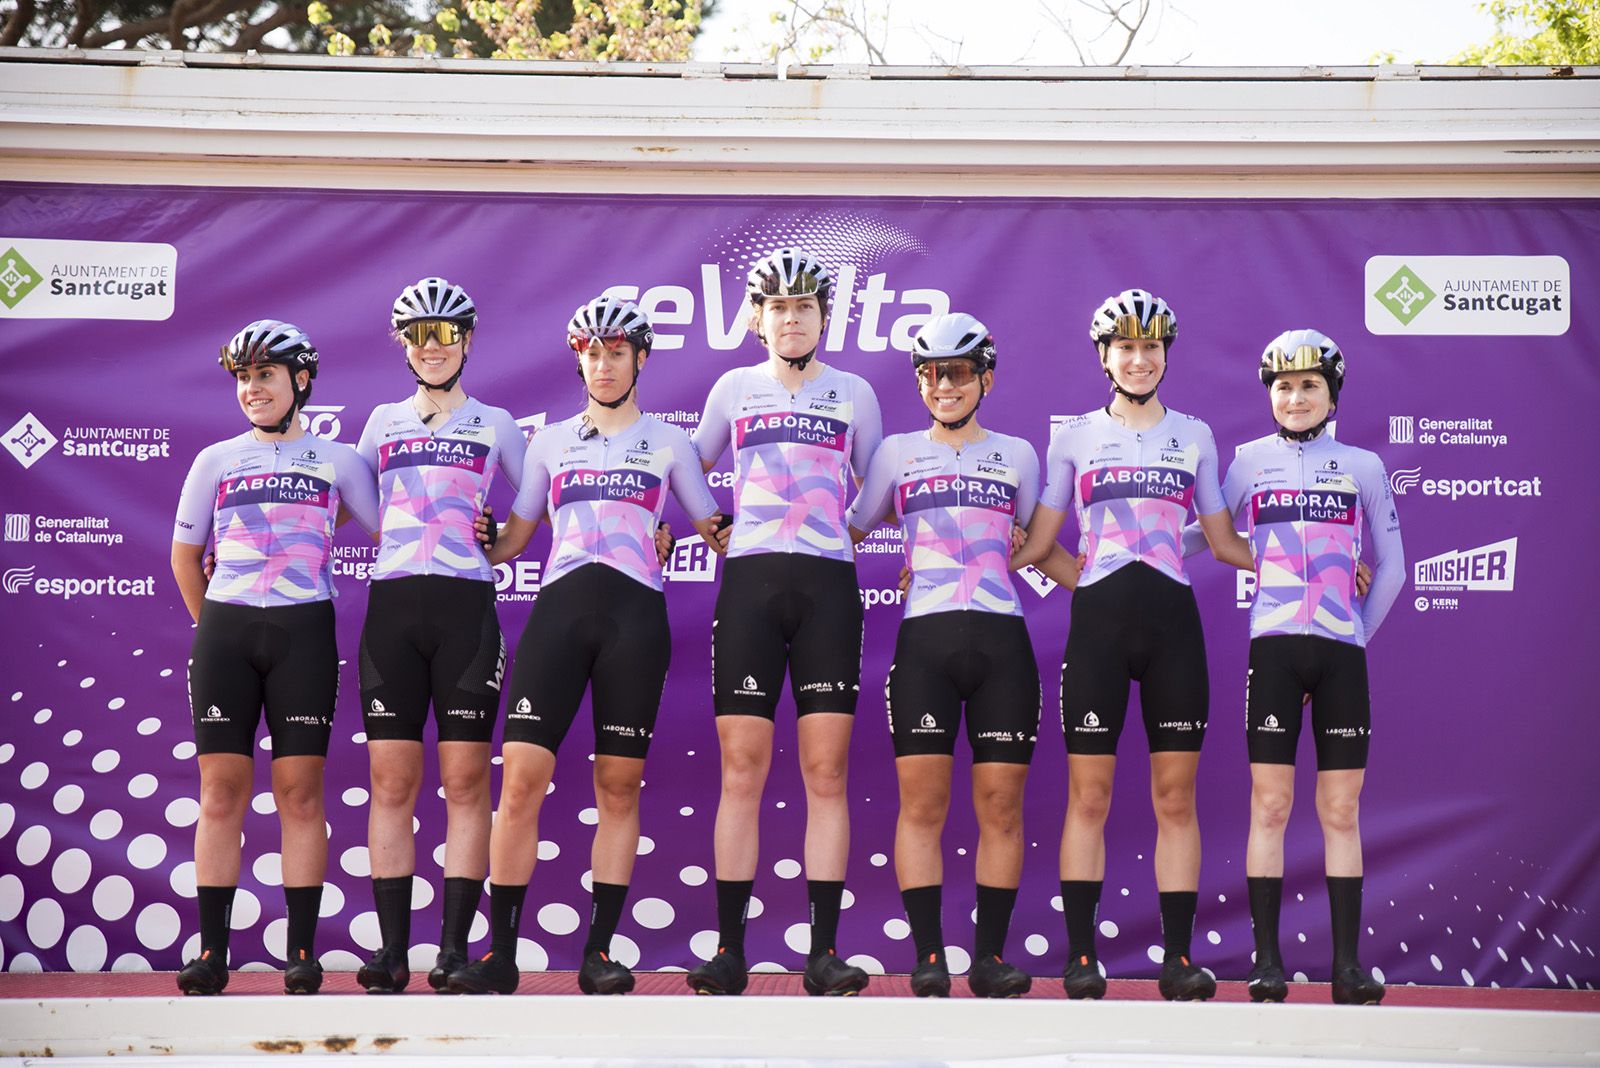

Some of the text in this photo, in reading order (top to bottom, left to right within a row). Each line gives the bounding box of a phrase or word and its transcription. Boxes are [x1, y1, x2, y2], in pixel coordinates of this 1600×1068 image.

[51, 264, 168, 278] AJUNTAMENT DE
[1444, 280, 1562, 292] AJUNTAMENT DE
[744, 415, 836, 434] LABORAL
[1419, 418, 1493, 430] Generalitat
[64, 427, 170, 440] AJUNTAMENT DE
[798, 430, 837, 445] kutxa
[1419, 432, 1508, 448] de Catalunya
[388, 440, 475, 457] LABORAL
[436, 454, 474, 466] kutxa
[226, 476, 319, 494] LABORAL
[561, 473, 646, 489] LABORAL
[1092, 470, 1185, 488] LABORAL
[608, 487, 645, 500] kutxa
[905, 478, 1011, 499] LABORAL
[1147, 485, 1184, 500] kutxa
[1422, 476, 1542, 500] esportcat
[279, 490, 320, 502] kutxa
[968, 494, 1011, 510] kutxa
[1257, 493, 1347, 509] LABORAL
[1309, 508, 1348, 520] kutxa
[35, 516, 109, 529] Generalitat
[35, 530, 123, 546] de Catalunya
[854, 542, 905, 553] Catalun
[1418, 550, 1507, 582] FINISHER
[35, 575, 155, 599] esportcat
[1432, 598, 1459, 606] KERN
[800, 682, 832, 691] LABORAL
[603, 725, 635, 733] LABORAL
